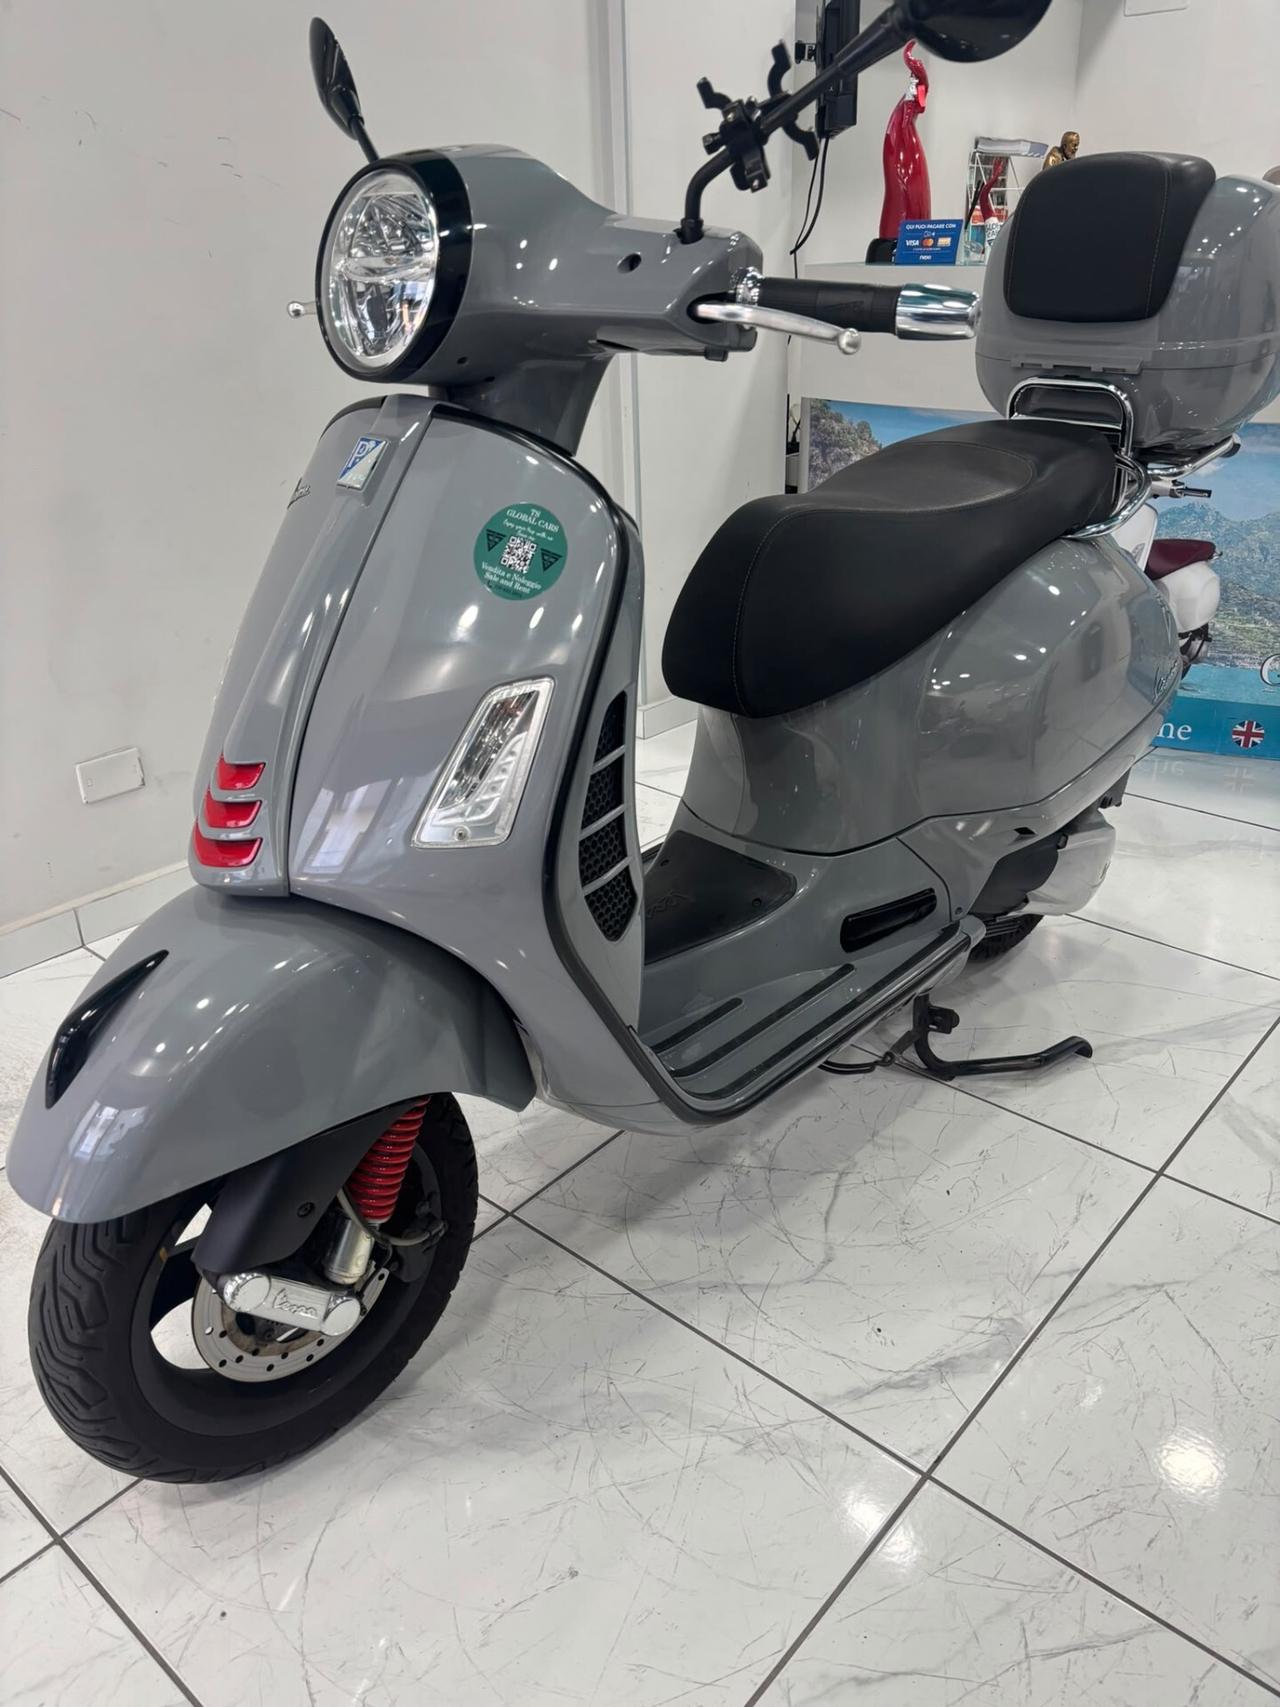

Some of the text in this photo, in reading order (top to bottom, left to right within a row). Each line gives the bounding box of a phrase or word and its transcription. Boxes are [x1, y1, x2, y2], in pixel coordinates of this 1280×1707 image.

[506, 509, 560, 533] GLOBAL CARS
[481, 561, 506, 577] Vendita
[512, 573, 542, 590] Noleggio
[484, 571, 500, 582] Sale
[500, 578, 513, 587] and
[513, 583, 531, 594] Rent
[272, 1287, 318, 1320] Vespa
